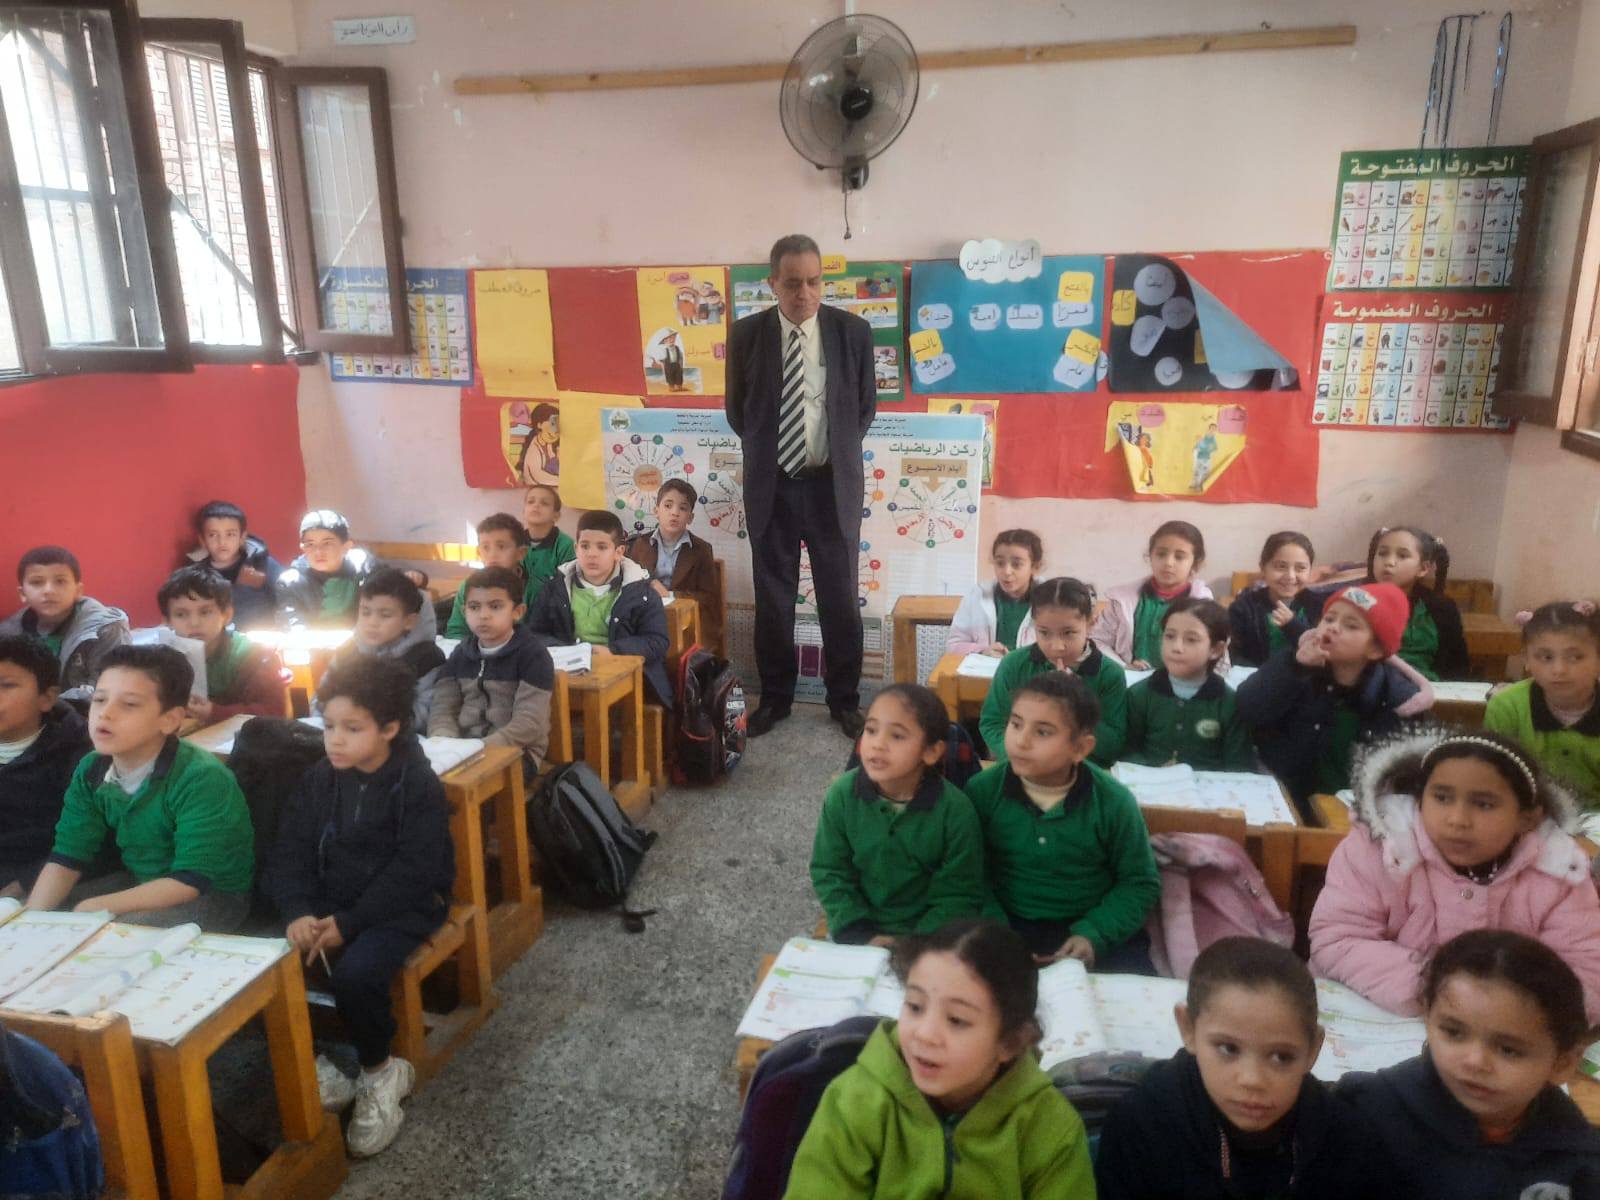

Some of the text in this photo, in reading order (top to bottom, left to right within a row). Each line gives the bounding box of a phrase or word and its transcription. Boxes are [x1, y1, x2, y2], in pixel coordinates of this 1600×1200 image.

[1350, 153, 1515, 179] الحروف المفتوحة
[407, 277, 438, 290] الحر
[1333, 298, 1493, 321] الحروف المضمومة
[697, 438, 743, 451] رياضيات
[889, 441, 977, 457] ركن الرياضيات
